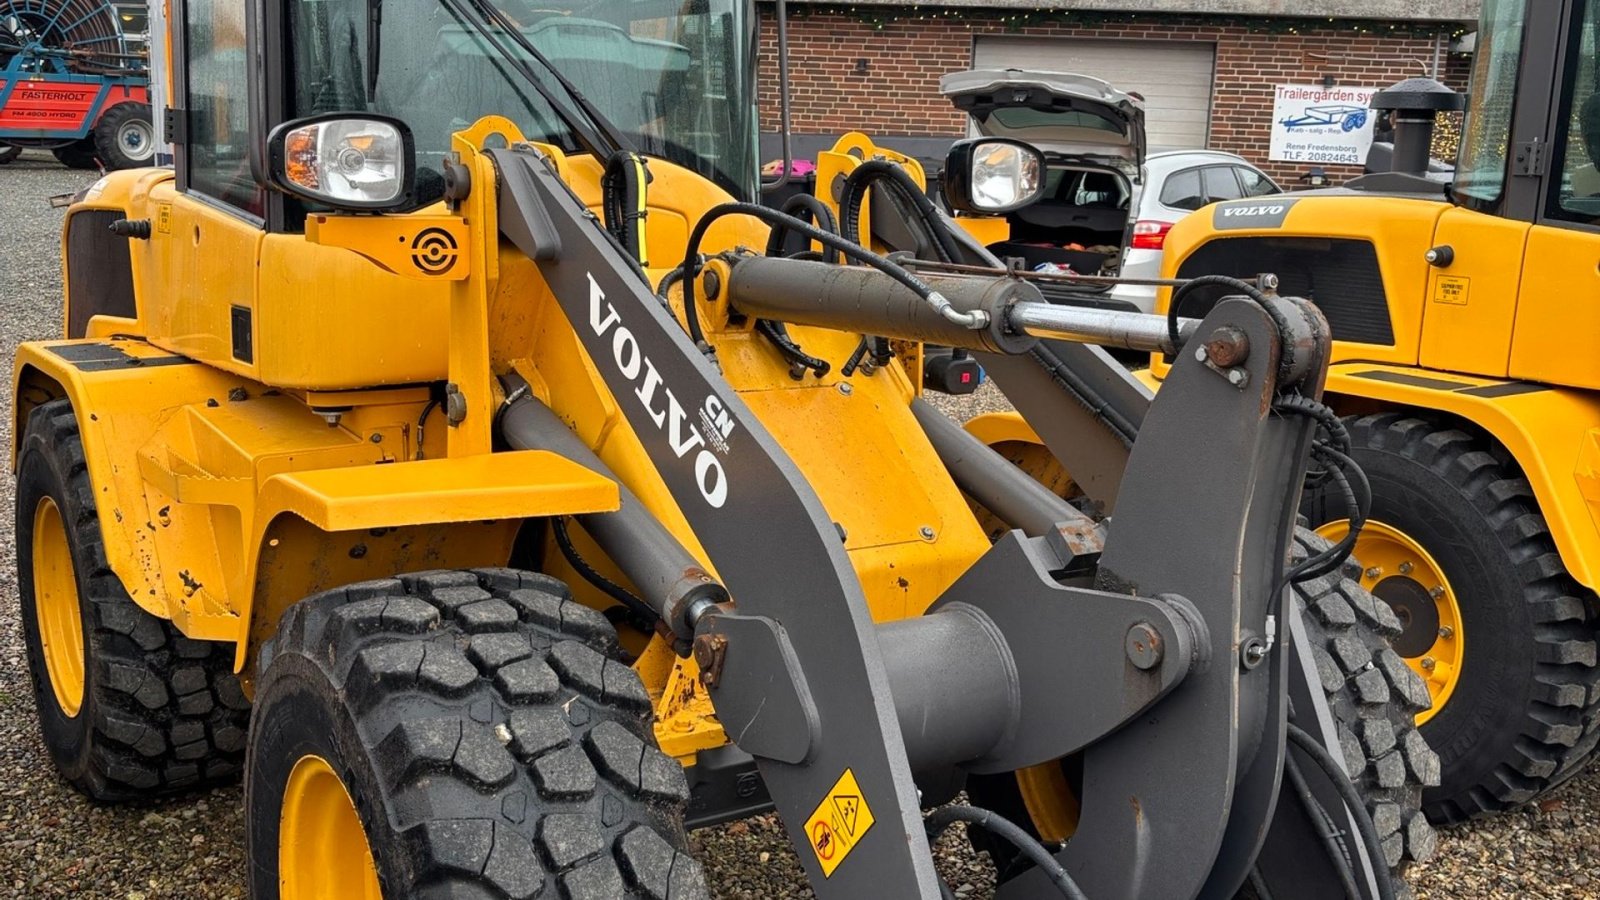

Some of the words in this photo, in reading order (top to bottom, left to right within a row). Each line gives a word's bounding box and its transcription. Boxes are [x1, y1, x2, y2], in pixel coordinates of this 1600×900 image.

[21, 91, 87, 101] FASTERHOLT
[1277, 86, 1354, 103] Trailergården
[1309, 127, 1323, 135] salg
[1286, 142, 1306, 150] Rene
[1307, 143, 1357, 153] Fredensborg
[1282, 151, 1305, 160] TLF.
[1308, 152, 1359, 163] 20824643
[1224, 205, 1284, 217] VOLVO
[586, 271, 728, 509] VOLVO
[705, 394, 735, 439] CN
